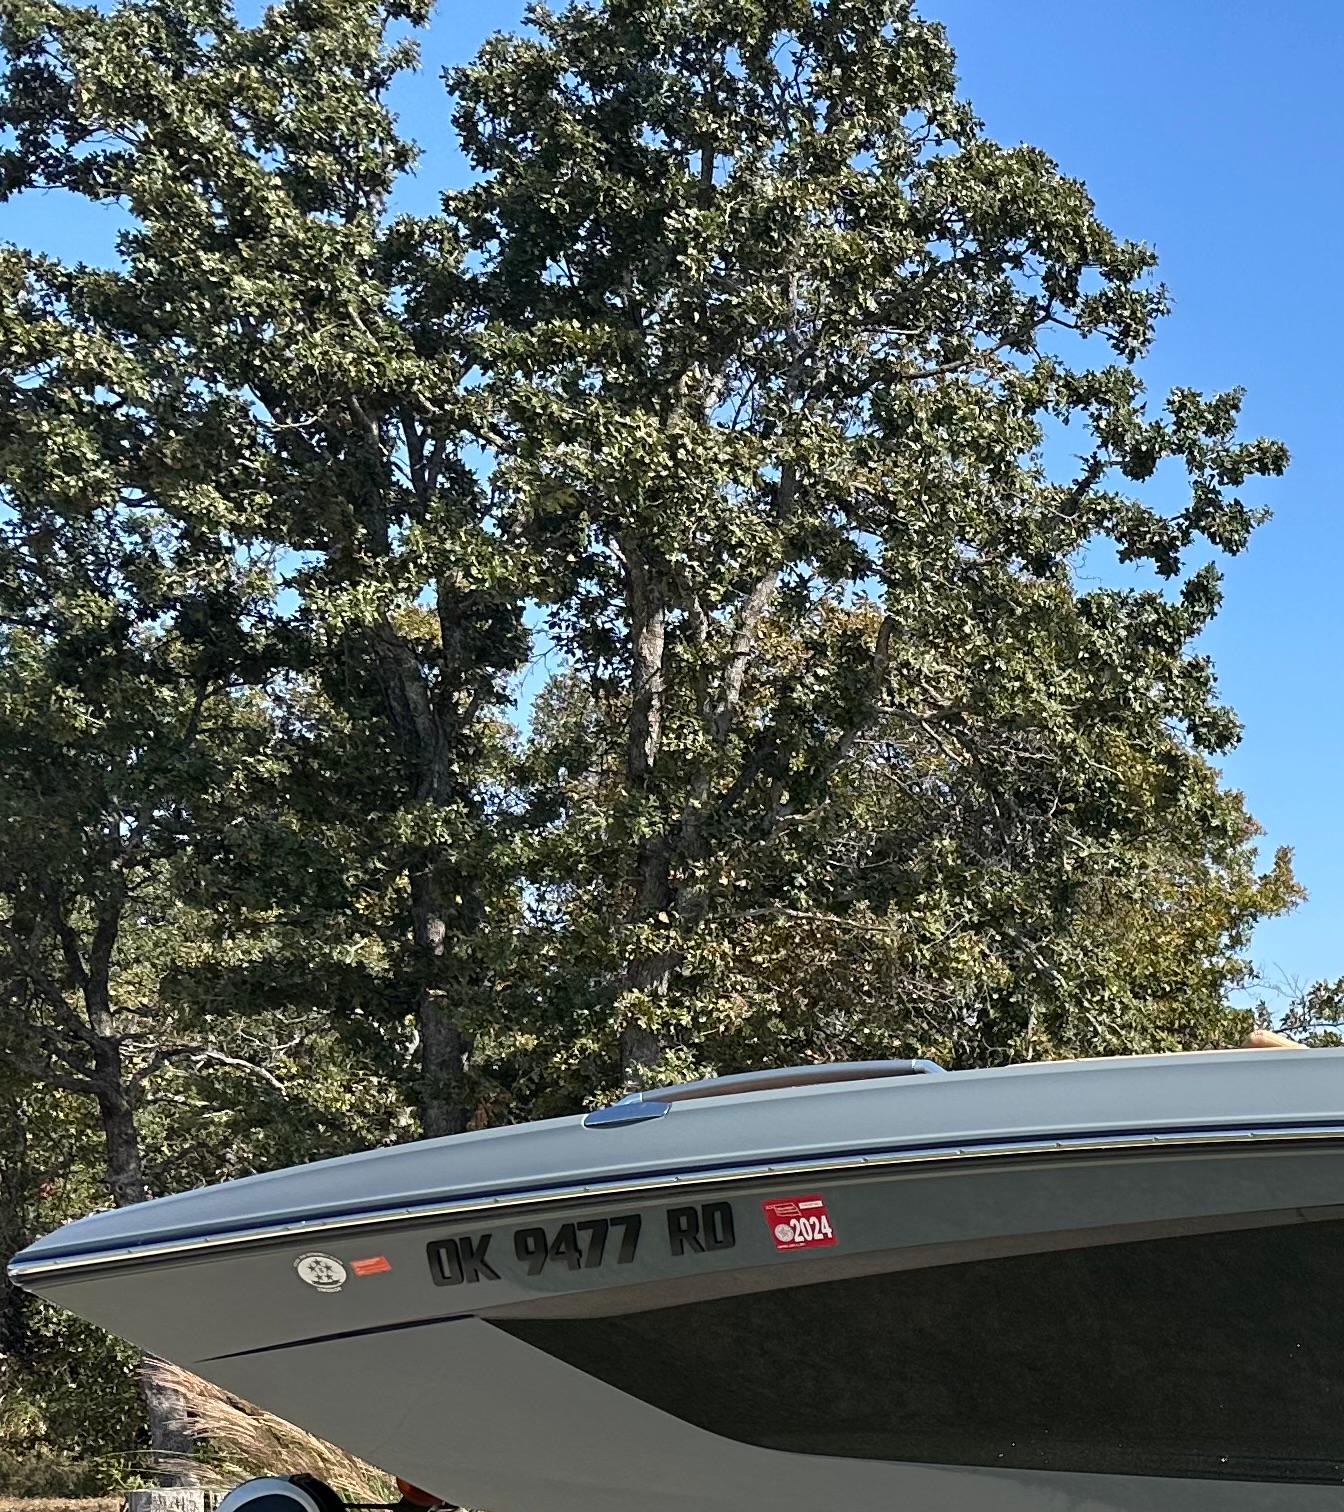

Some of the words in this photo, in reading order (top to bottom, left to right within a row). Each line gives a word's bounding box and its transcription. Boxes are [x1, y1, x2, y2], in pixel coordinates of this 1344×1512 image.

[426, 1233, 501, 1287] OK
[514, 1213, 642, 1276] 9477
[666, 1202, 736, 1256] RD
[789, 1215, 833, 1242] 2024
